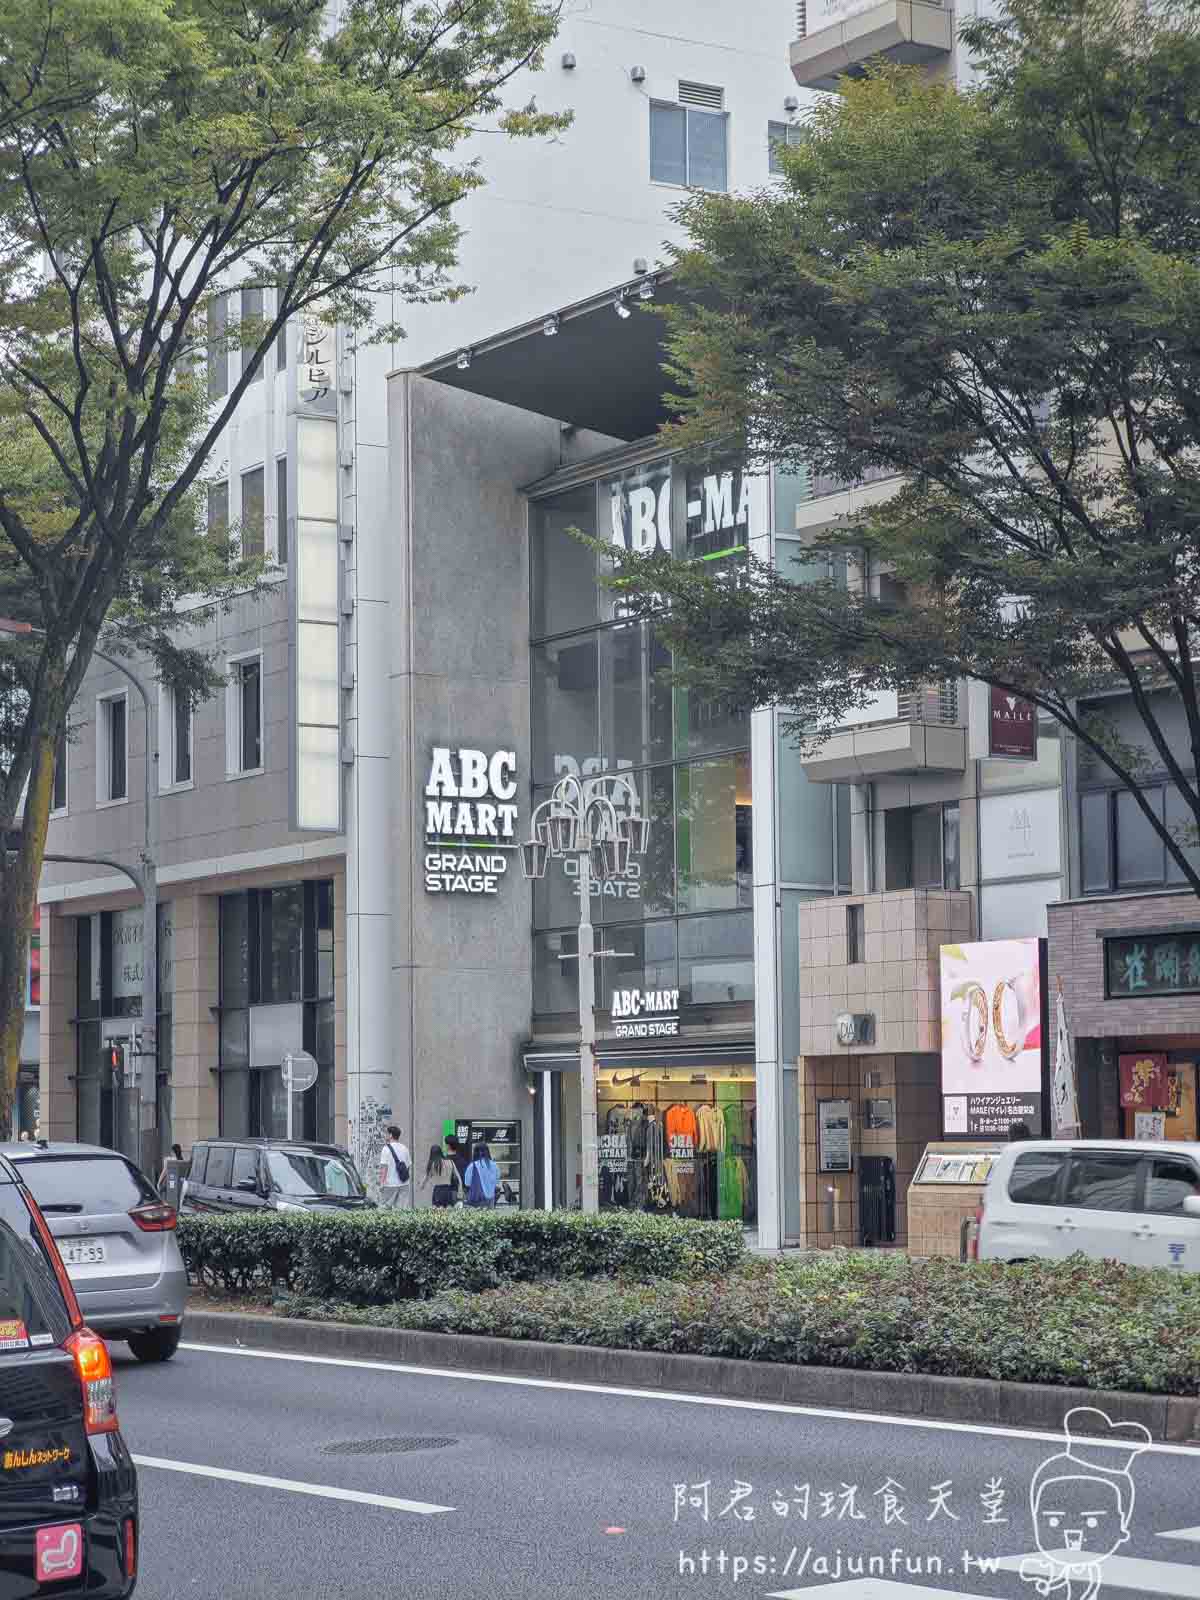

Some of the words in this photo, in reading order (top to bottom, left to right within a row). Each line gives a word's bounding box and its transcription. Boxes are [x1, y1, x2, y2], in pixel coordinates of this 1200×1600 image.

[993, 710, 1033, 721] MAILE
[425, 747, 518, 800] ABC
[425, 800, 518, 837] MART
[425, 853, 507, 873] GRAND
[425, 873, 498, 893] STAGE
[611, 989, 680, 1016] ABC-MART
[615, 1024, 648, 1039] GRAND
[648, 1022, 678, 1036] STAGE
[970, 1096, 1022, 1105] ハワイアンジュエリー
[4, 1448, 70, 1470] あんしんネットワーク
